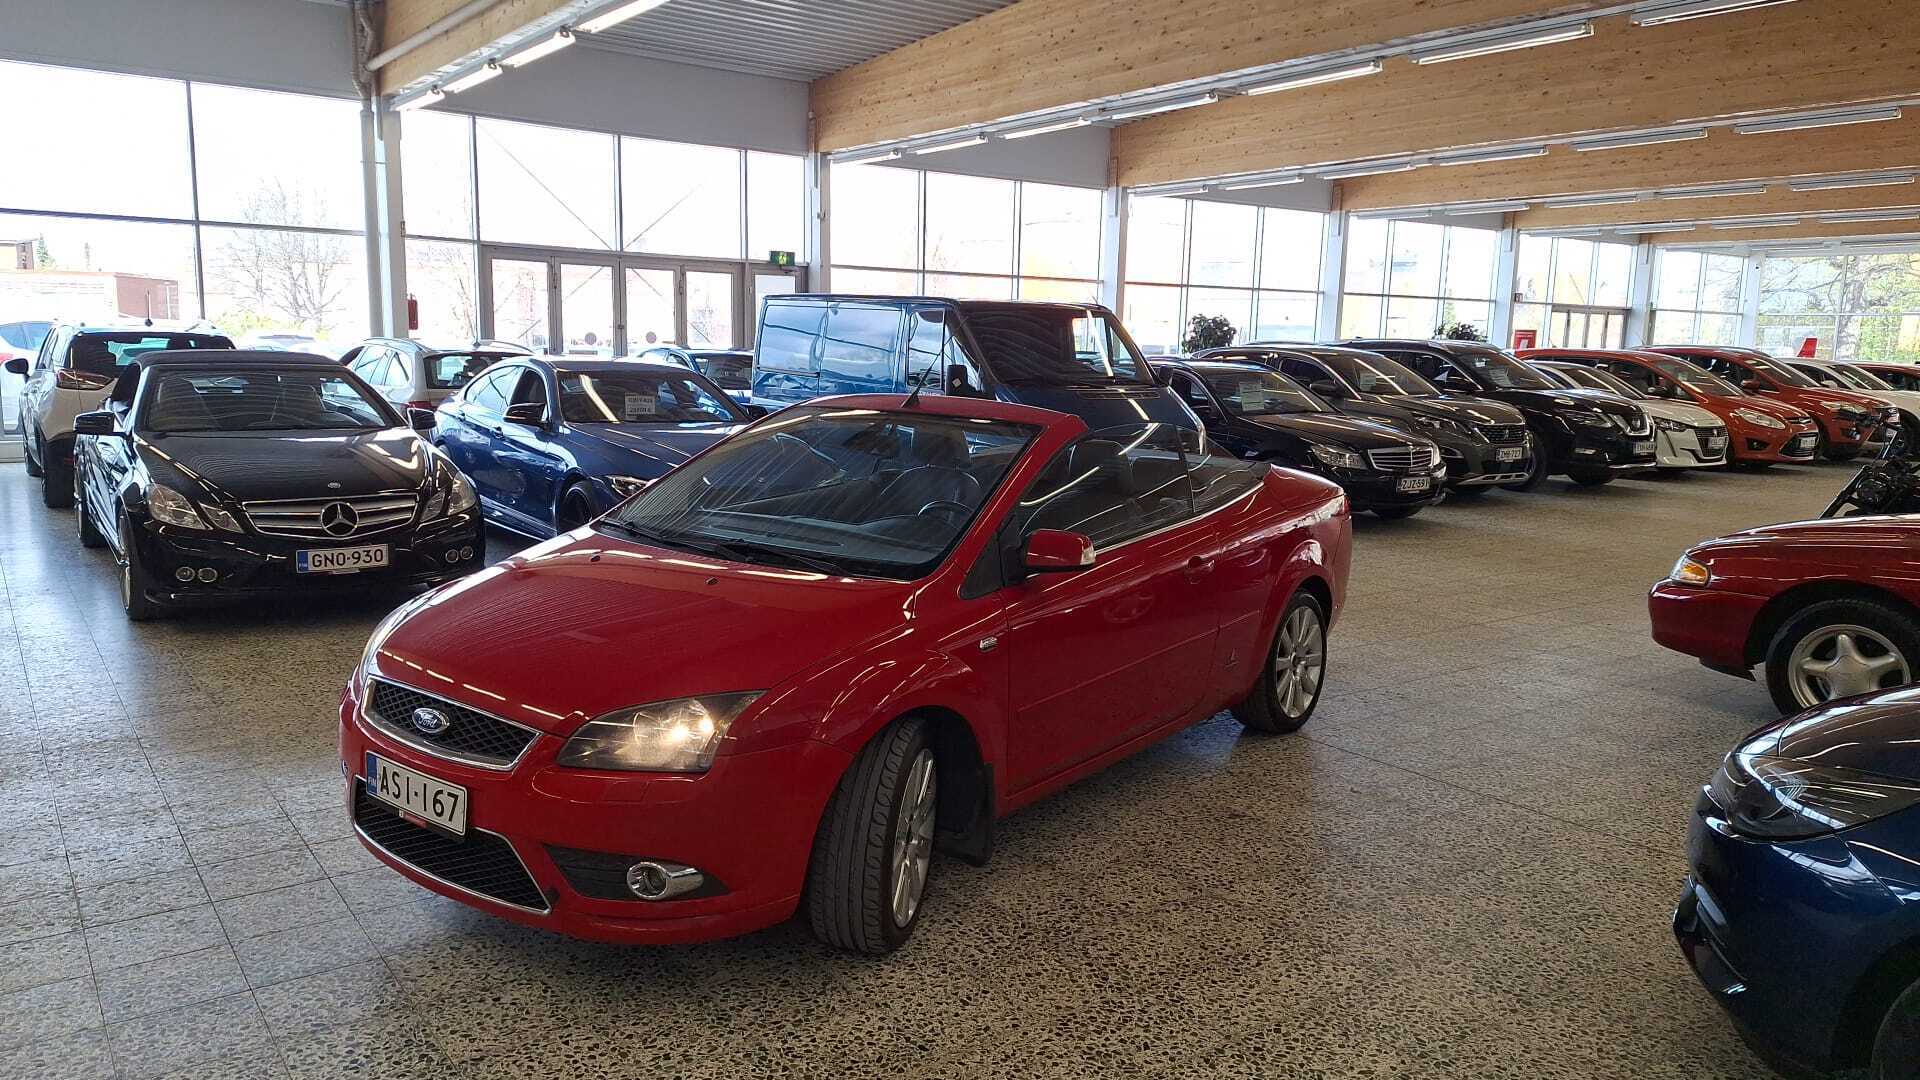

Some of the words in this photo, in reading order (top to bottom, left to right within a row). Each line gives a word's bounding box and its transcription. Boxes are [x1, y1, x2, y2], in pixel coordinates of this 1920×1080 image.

[1402, 479, 1429, 489] ZJZ-591
[311, 548, 384, 568] GNO-930
[417, 712, 438, 728] Ford
[380, 765, 459, 822] ASI-167
